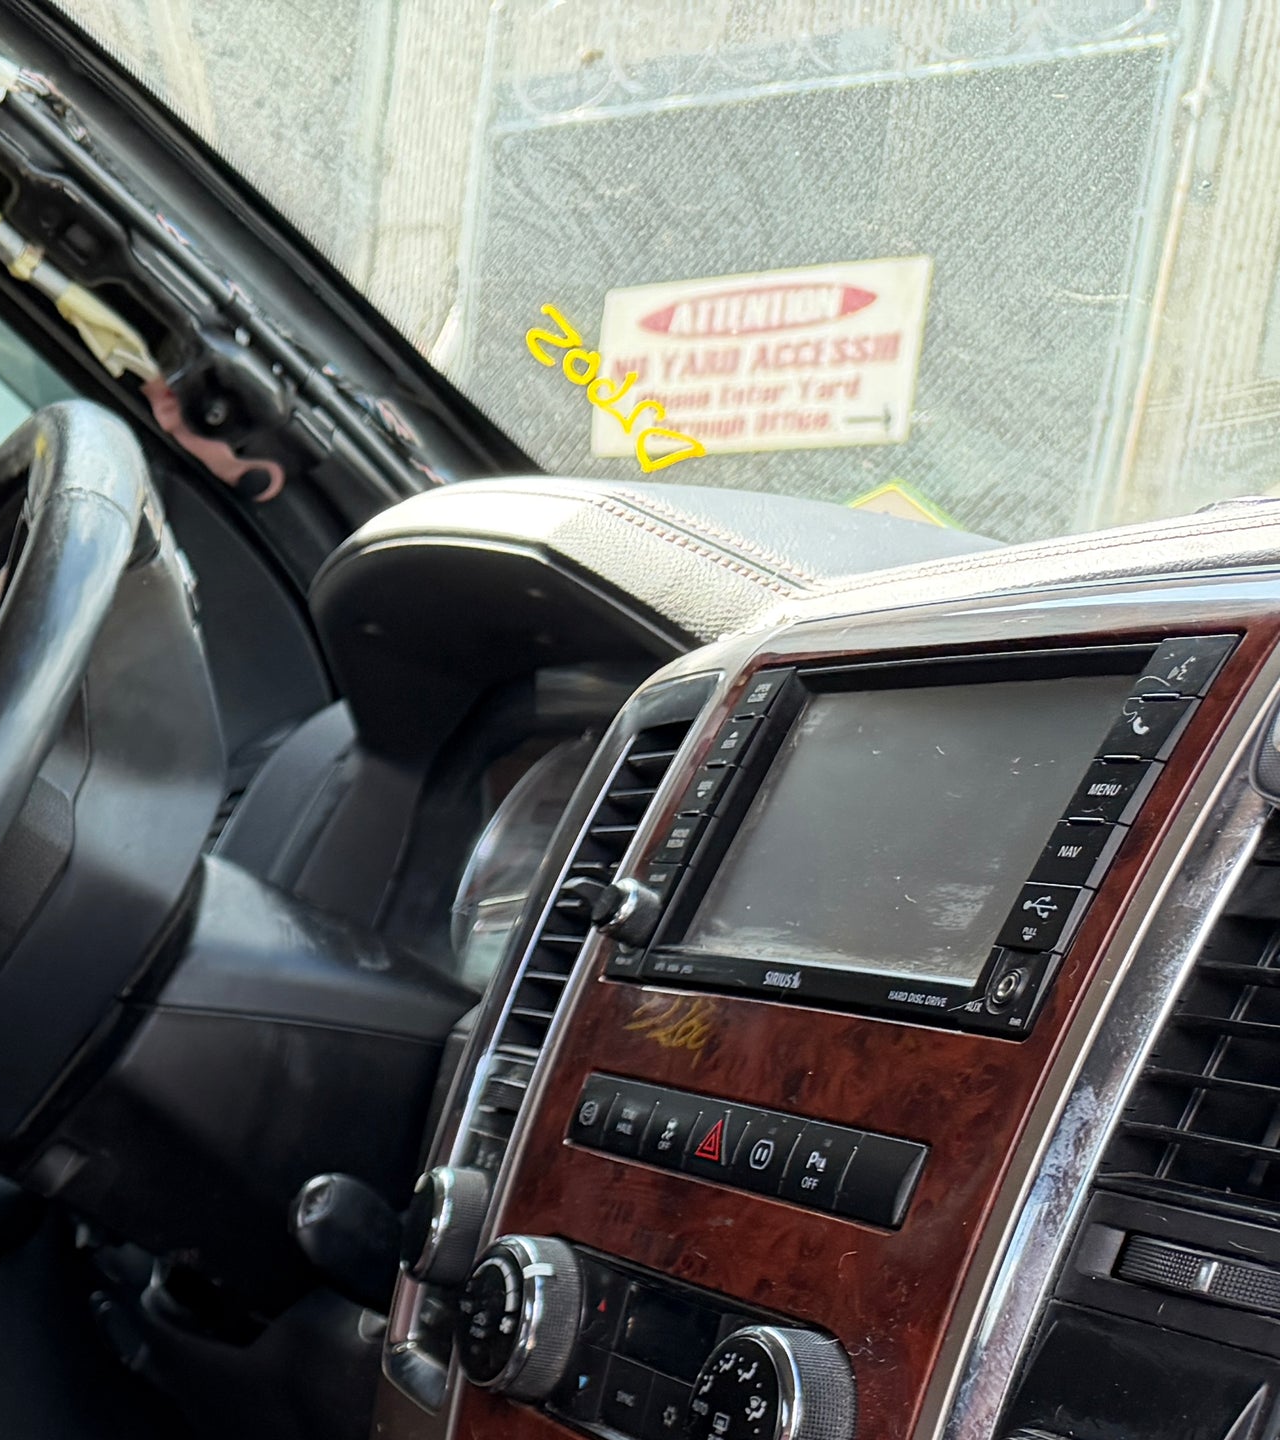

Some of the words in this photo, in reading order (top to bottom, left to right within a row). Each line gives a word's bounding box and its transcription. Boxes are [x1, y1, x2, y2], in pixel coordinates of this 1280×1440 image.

[1087, 783, 1122, 796] MENU
[1057, 846, 1083, 858] NAV
[1022, 927, 1038, 937] PULL
[763, 970, 793, 988] SIRIUS
[888, 991, 907, 1002] HARD
[964, 1001, 983, 1013] AUX
[657, 1141, 672, 1150] OFF
[801, 1176, 819, 1190] OFF
